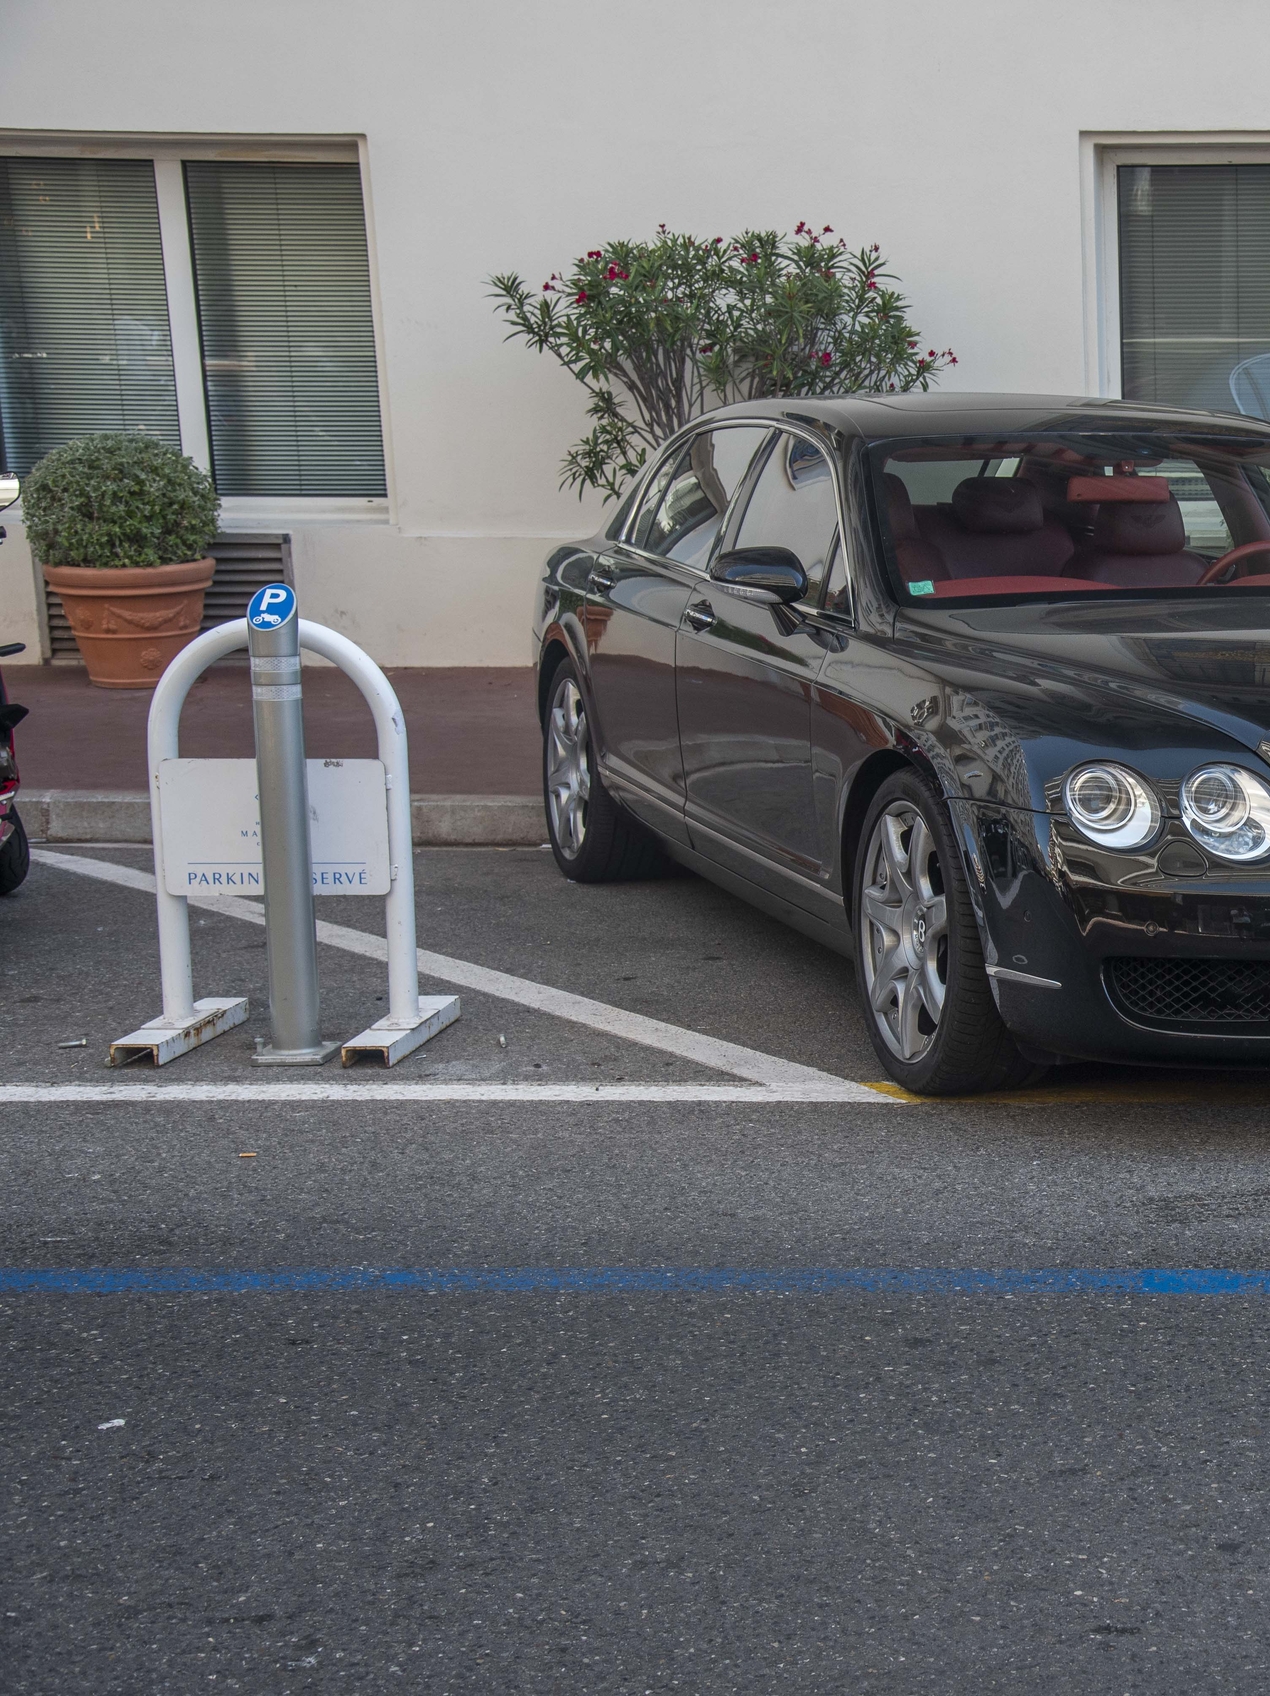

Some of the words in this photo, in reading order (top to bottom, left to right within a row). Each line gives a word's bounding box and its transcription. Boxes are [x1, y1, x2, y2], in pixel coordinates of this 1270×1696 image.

[259, 588, 287, 611] P
[187, 872, 260, 885] PARKIN
[312, 869, 368, 885] SERVÉ
